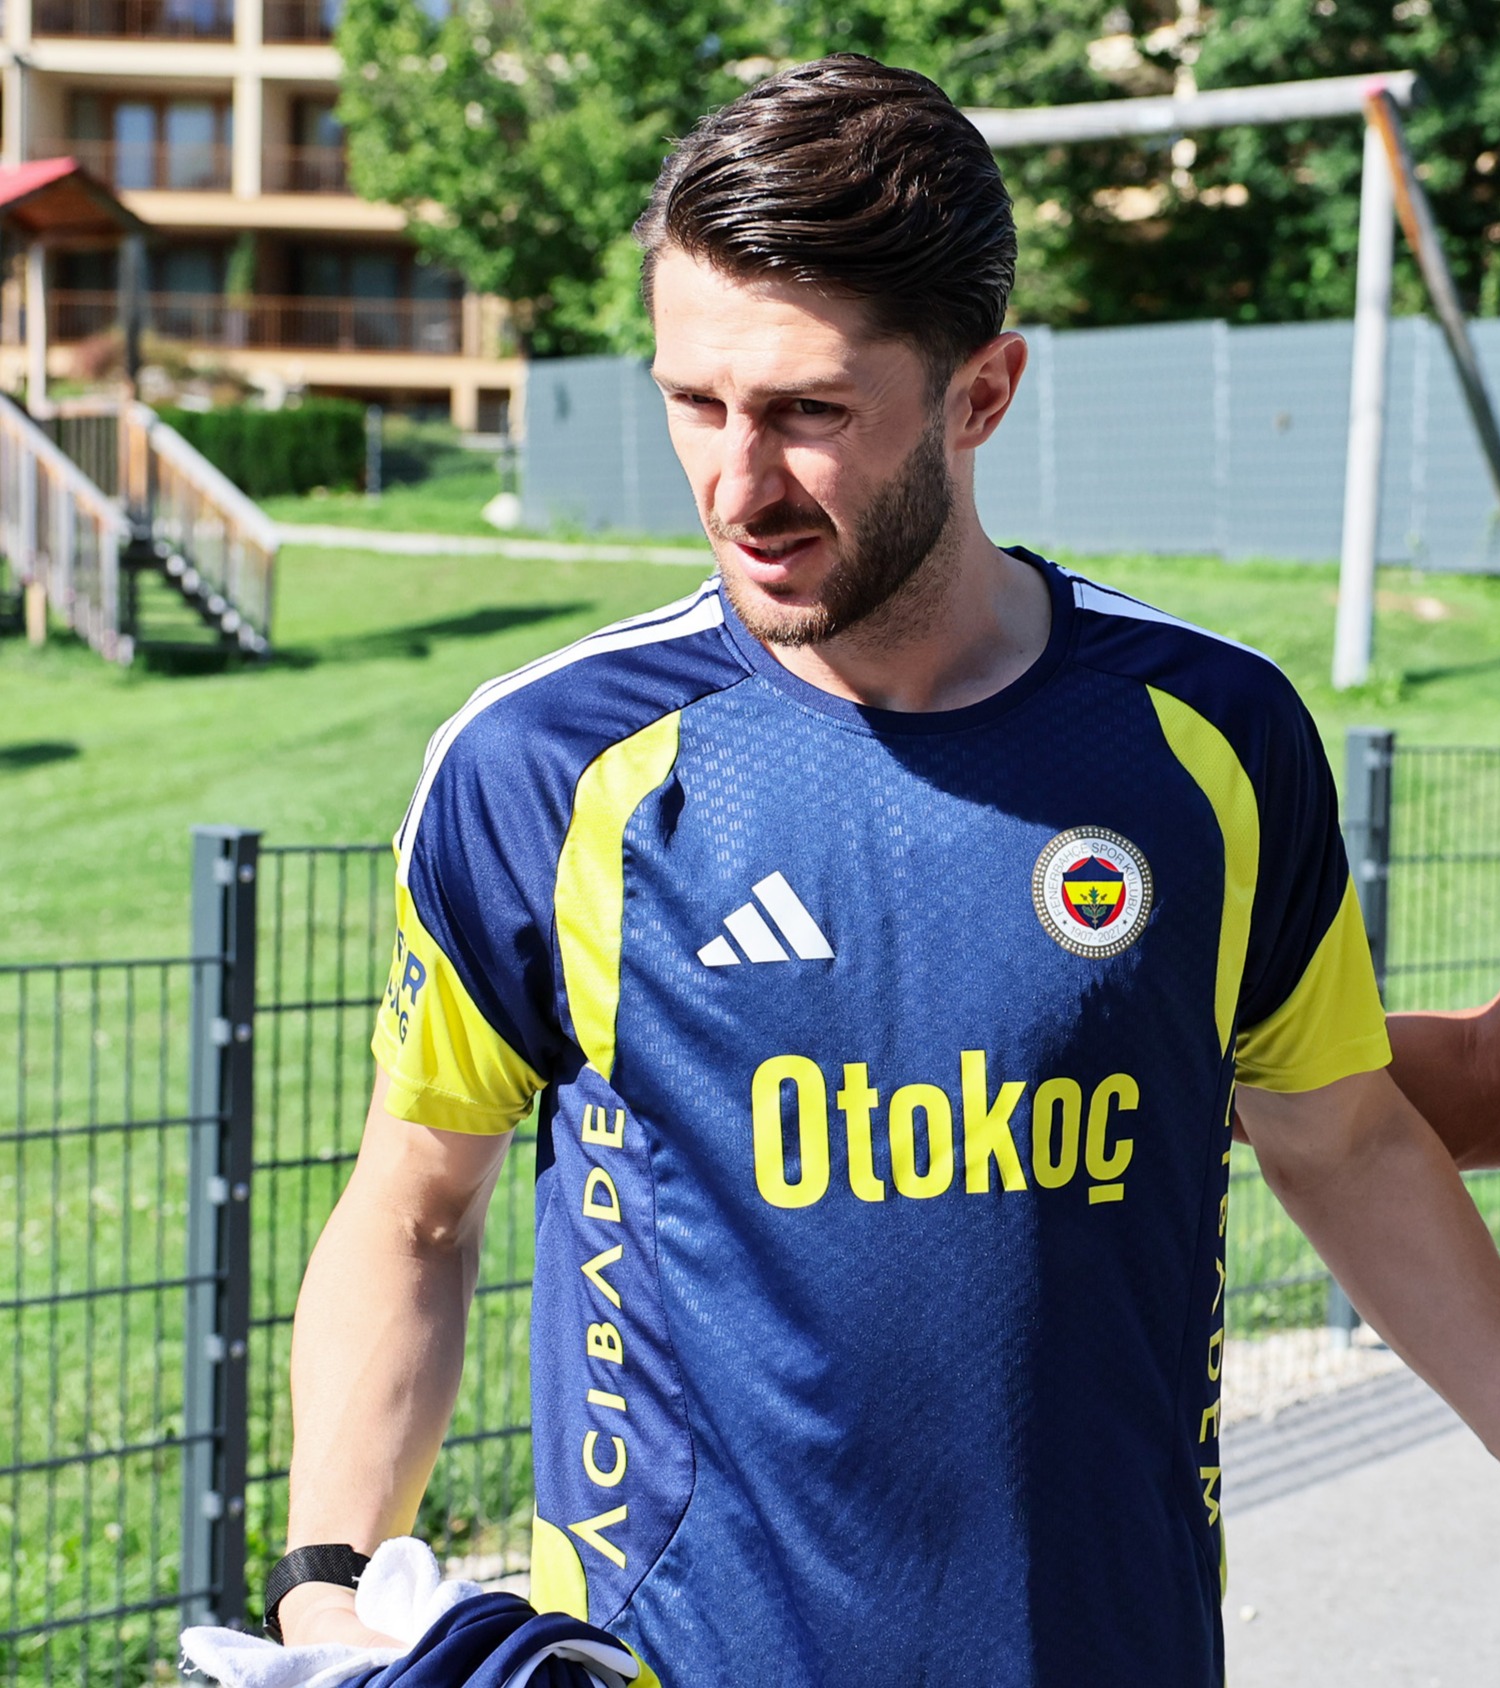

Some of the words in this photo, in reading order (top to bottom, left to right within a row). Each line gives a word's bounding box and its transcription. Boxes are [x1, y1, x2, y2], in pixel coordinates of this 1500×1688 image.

[1048, 843, 1089, 917] FENERBAHÇE
[1091, 842, 1125, 865] SPOR
[751, 1049, 1140, 1209] Otokoç
[568, 1104, 628, 1570] ACIBADE
